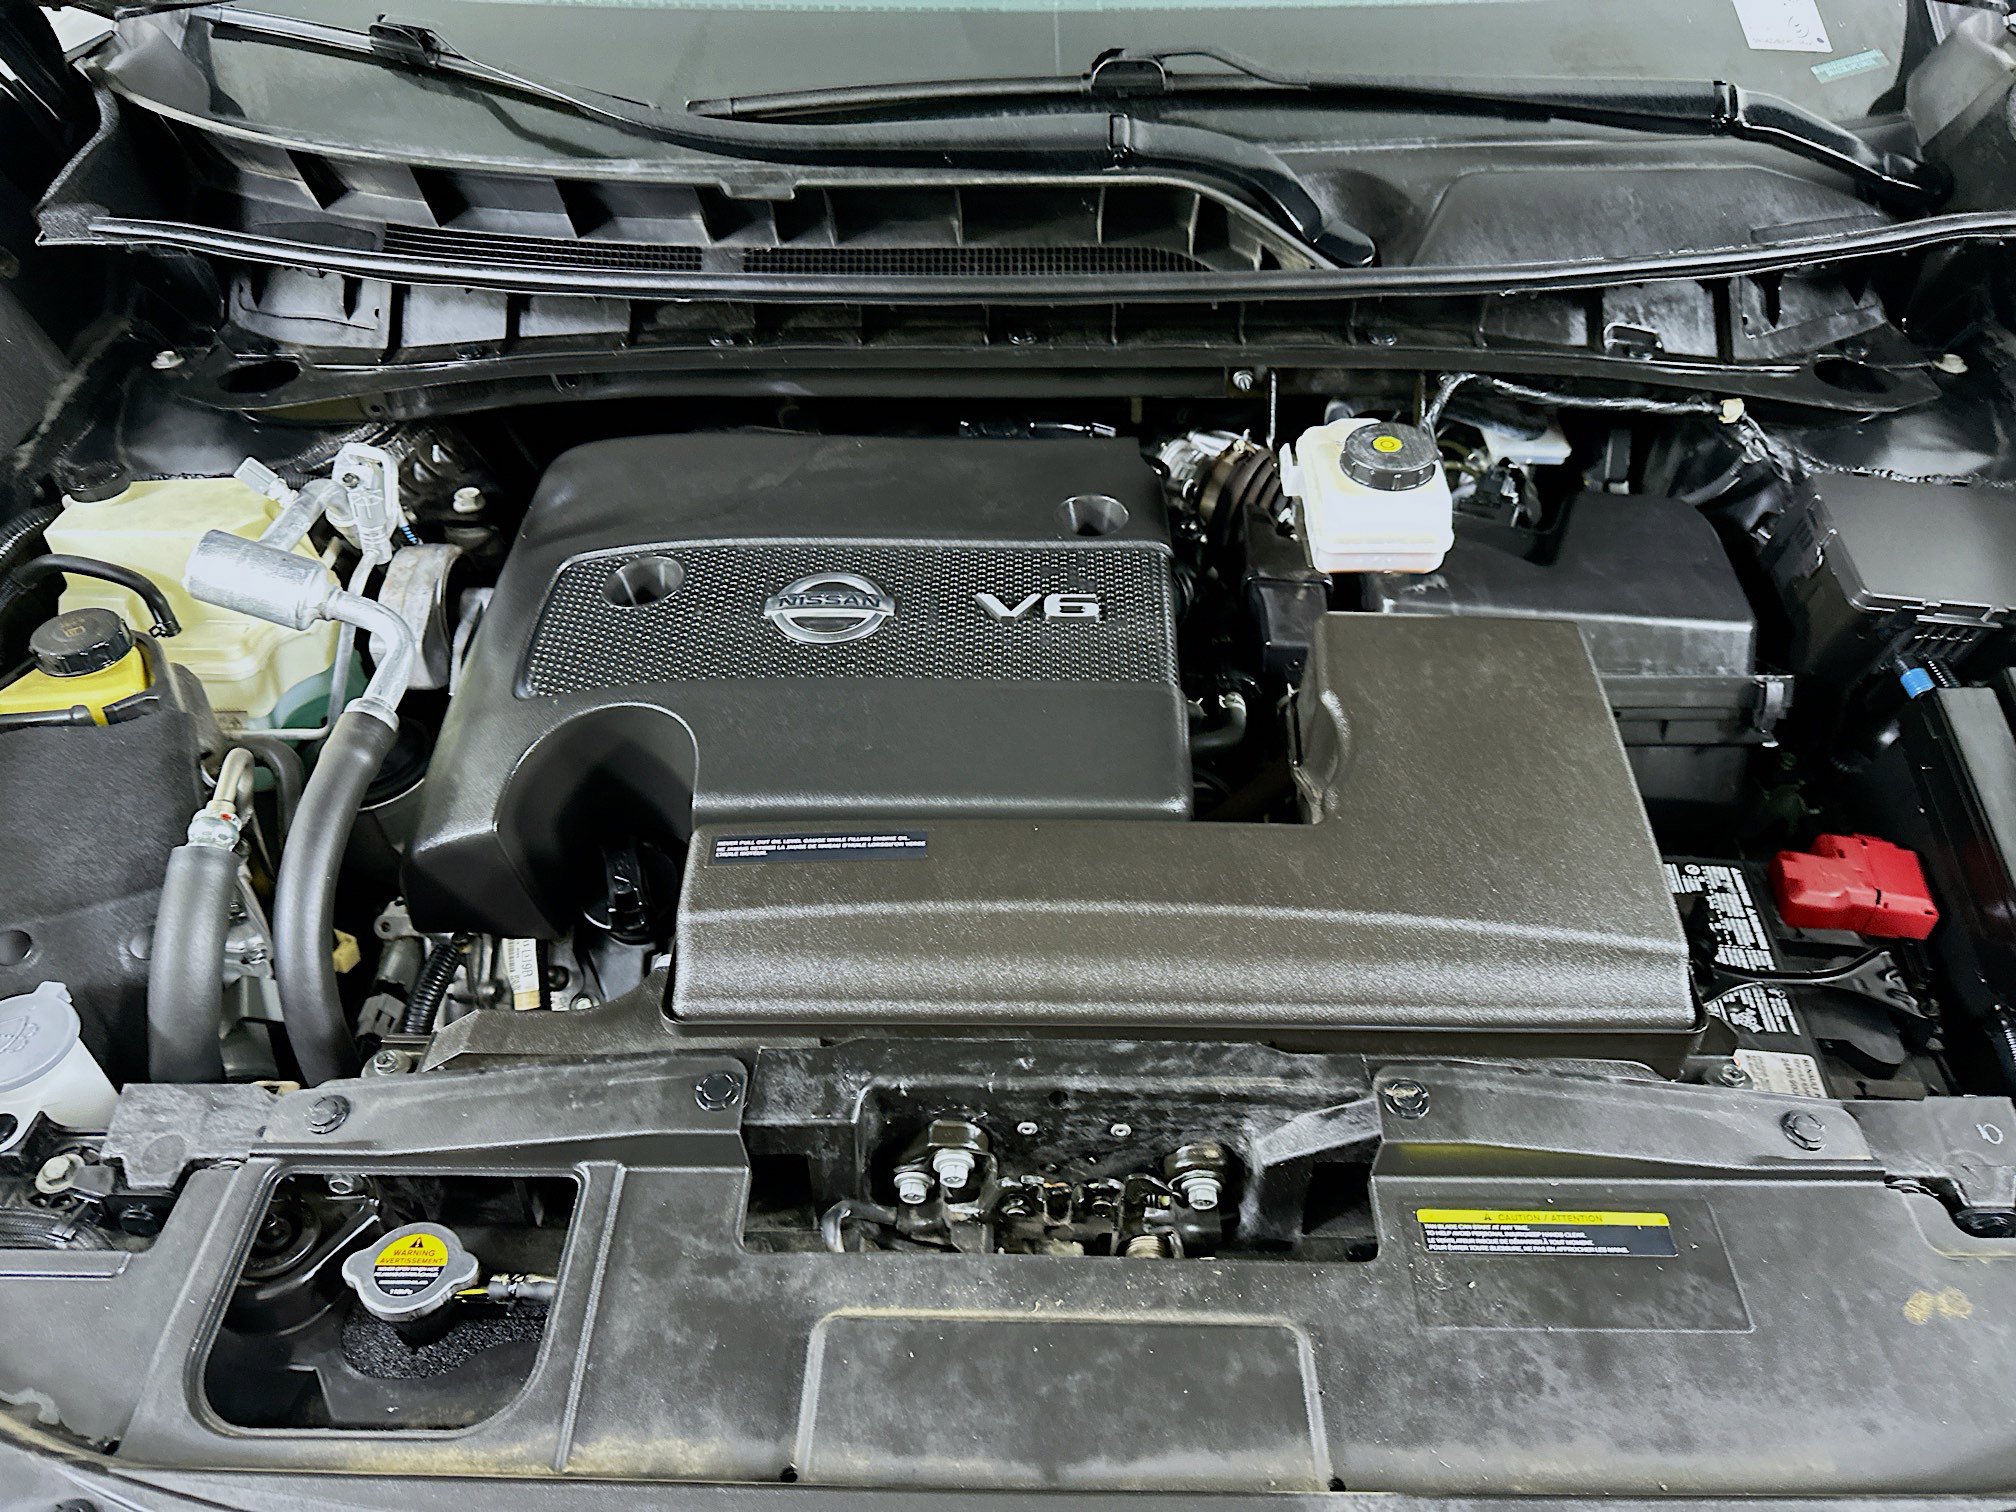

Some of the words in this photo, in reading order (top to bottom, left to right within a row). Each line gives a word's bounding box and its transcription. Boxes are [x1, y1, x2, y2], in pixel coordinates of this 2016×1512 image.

[779, 593, 881, 608] NISSAN
[976, 593, 1100, 622] V6
[1498, 1213, 1541, 1222] CAUTION
[1551, 1214, 1603, 1223] ATTENTION
[393, 1249, 436, 1257] WARNING
